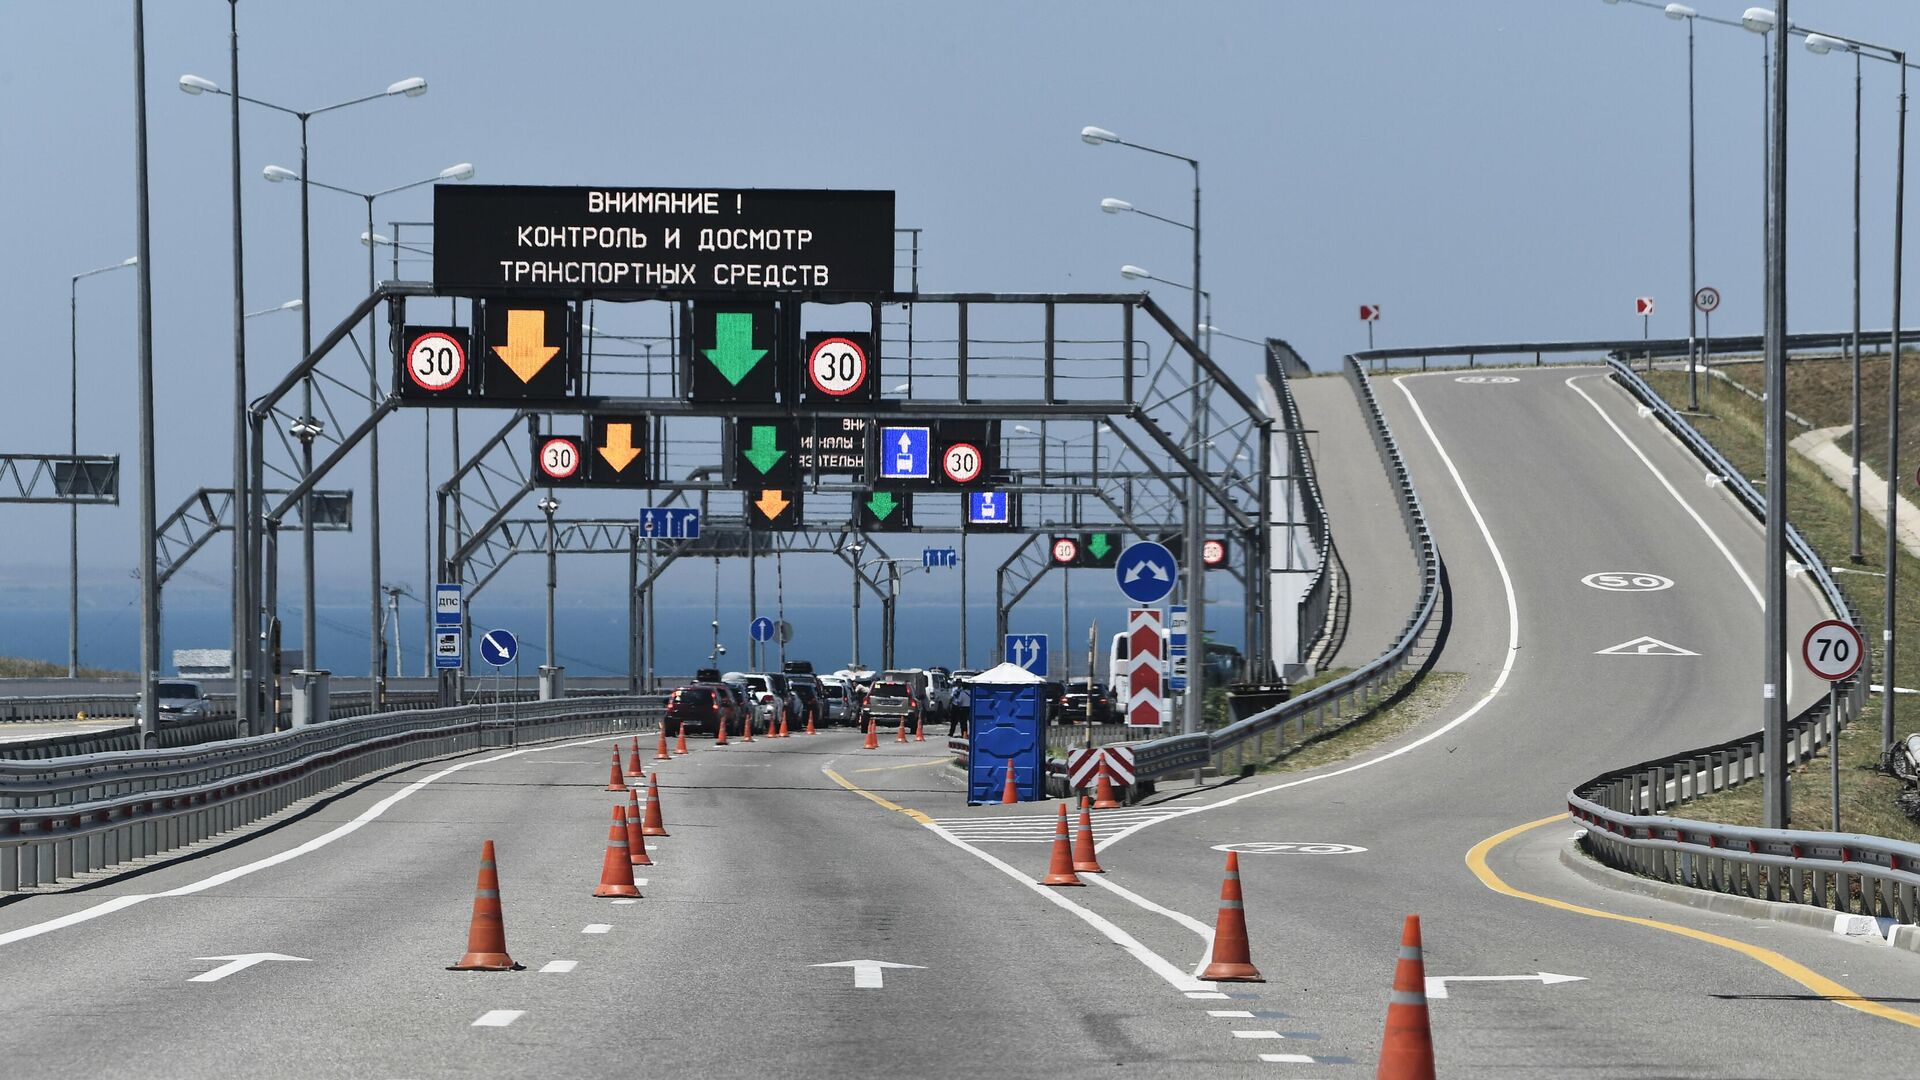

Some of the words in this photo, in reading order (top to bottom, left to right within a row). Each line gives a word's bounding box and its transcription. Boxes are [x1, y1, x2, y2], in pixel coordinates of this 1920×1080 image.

[588, 191, 719, 215] ВНИМАНИЕ
[735, 193, 745, 215] !
[517, 226, 648, 249] КОНТРОЛЬ
[664, 228, 681, 249] И
[697, 228, 813, 252] ДОСМОТР
[500, 260, 696, 285] ТРАНСПОРТНЫХ
[714, 264, 829, 287] СРЕДСТВ
[1700, 294, 1715, 305] 30
[418, 346, 453, 377] 30
[820, 352, 855, 382] 30
[547, 448, 571, 468] 30
[951, 453, 974, 473] 30
[1058, 545, 1071, 557] 30
[1598, 576, 1660, 587] 50
[438, 597, 458, 607] ДПС
[1171, 619, 1188, 628] ДП
[1816, 638, 1850, 663] 70
[1243, 843, 1345, 853] 70
